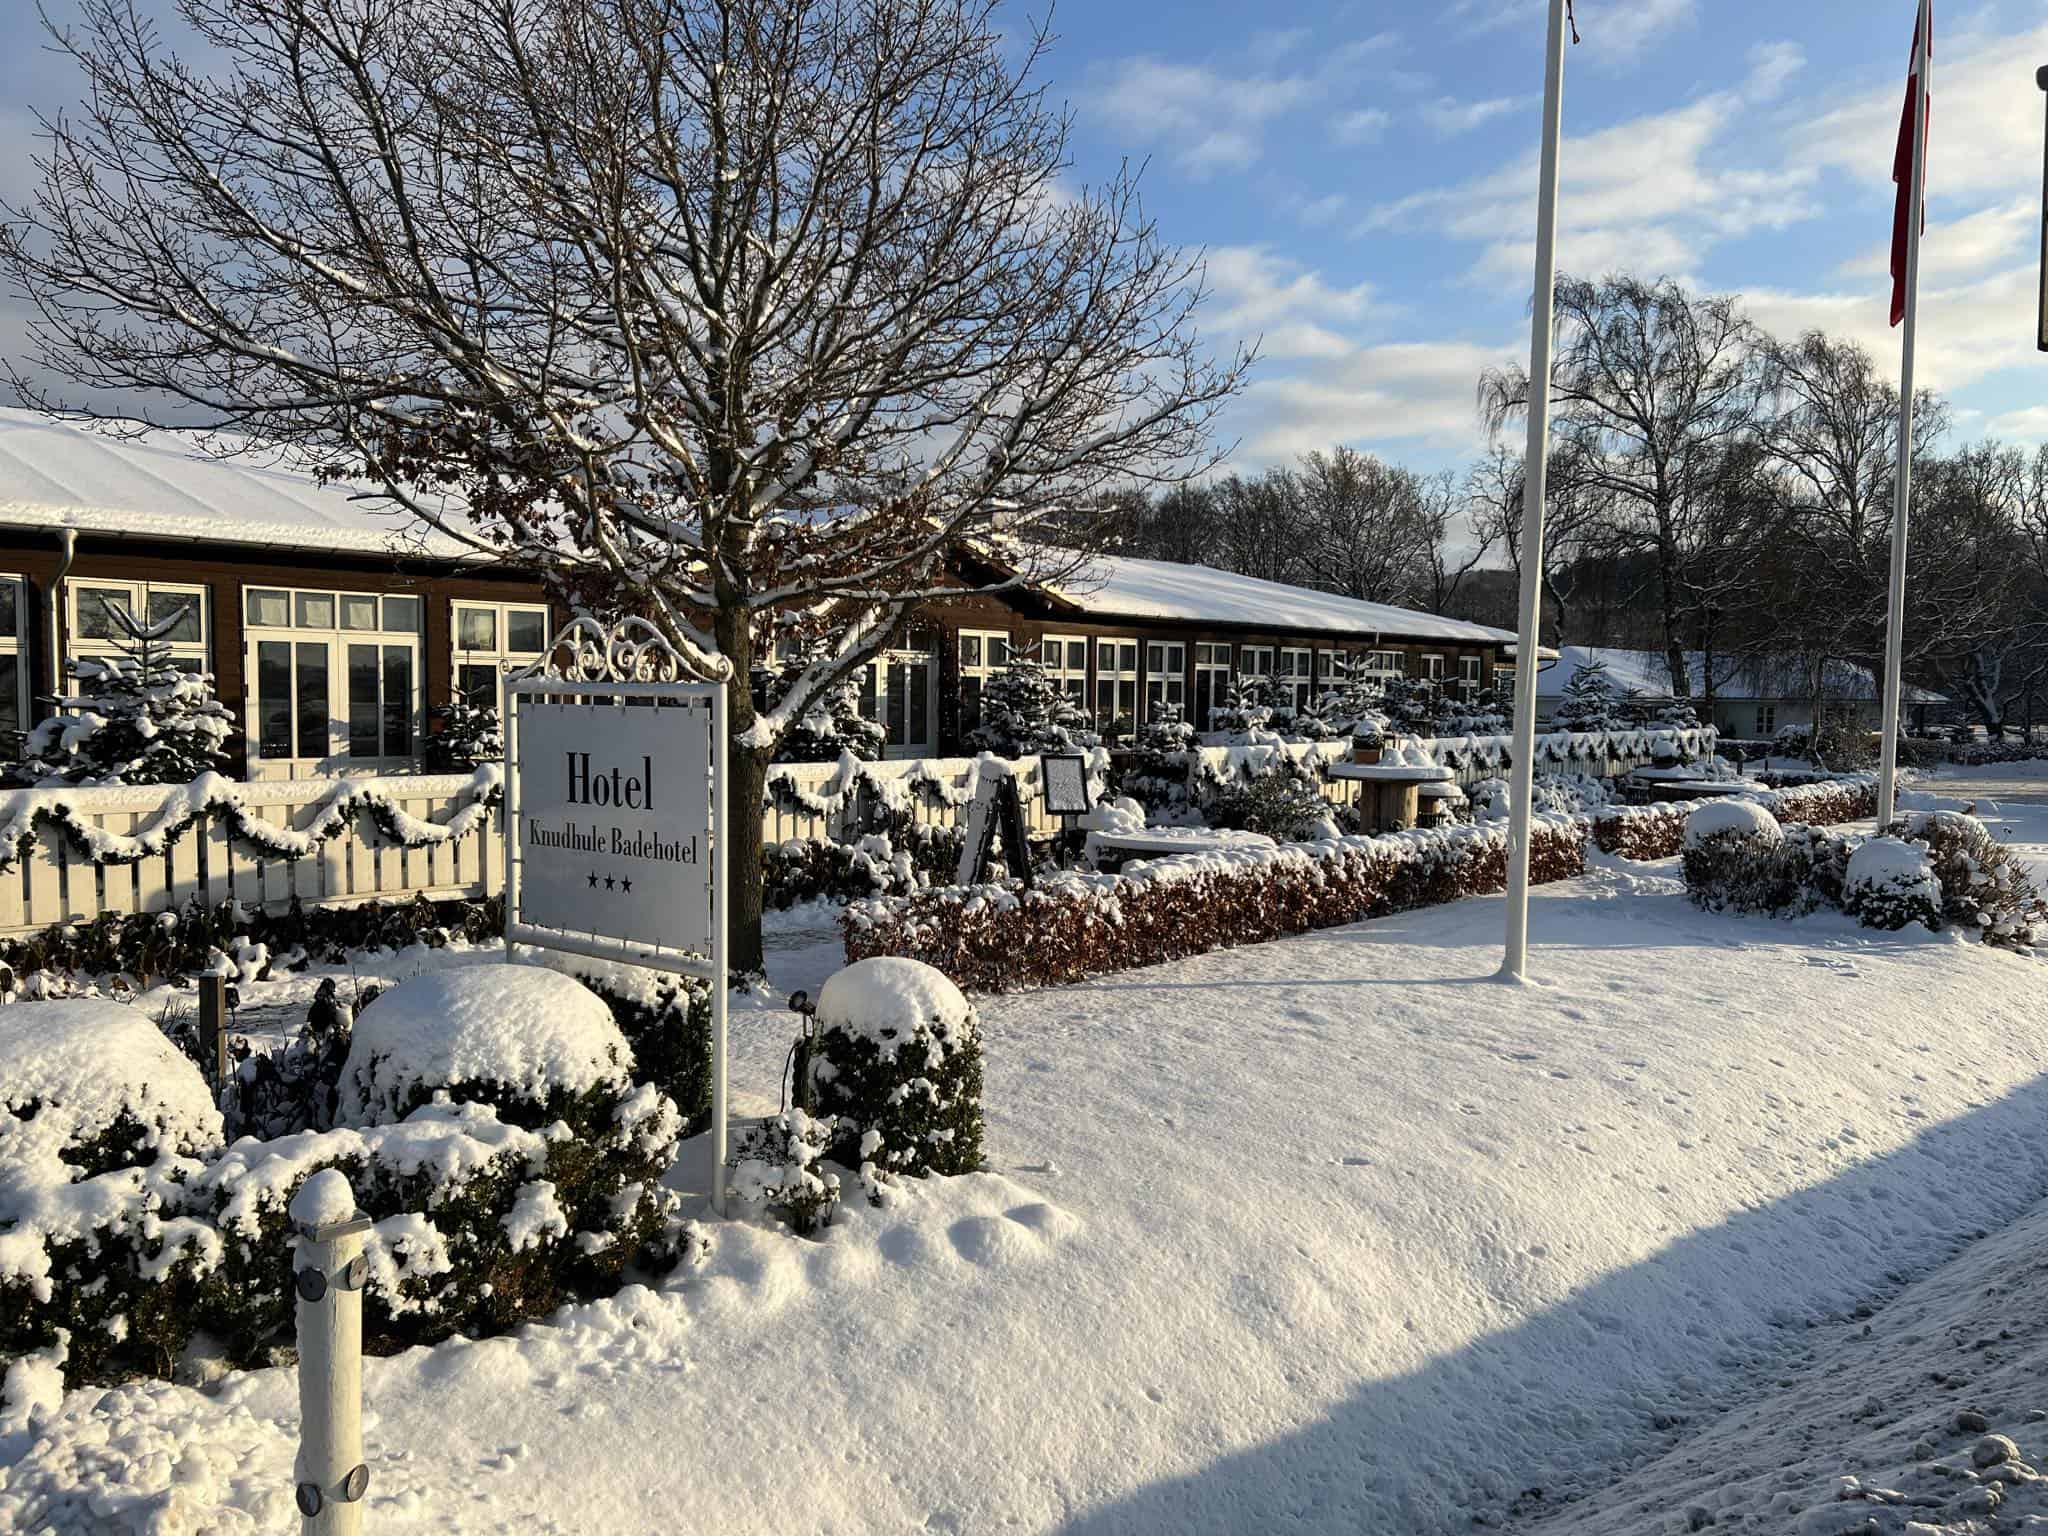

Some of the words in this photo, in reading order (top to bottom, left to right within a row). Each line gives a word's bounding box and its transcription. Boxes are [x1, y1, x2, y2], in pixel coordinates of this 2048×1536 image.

[566, 752, 653, 810] Hotel
[529, 819, 606, 852] Knudhule
[611, 827, 697, 864] Badehotel
